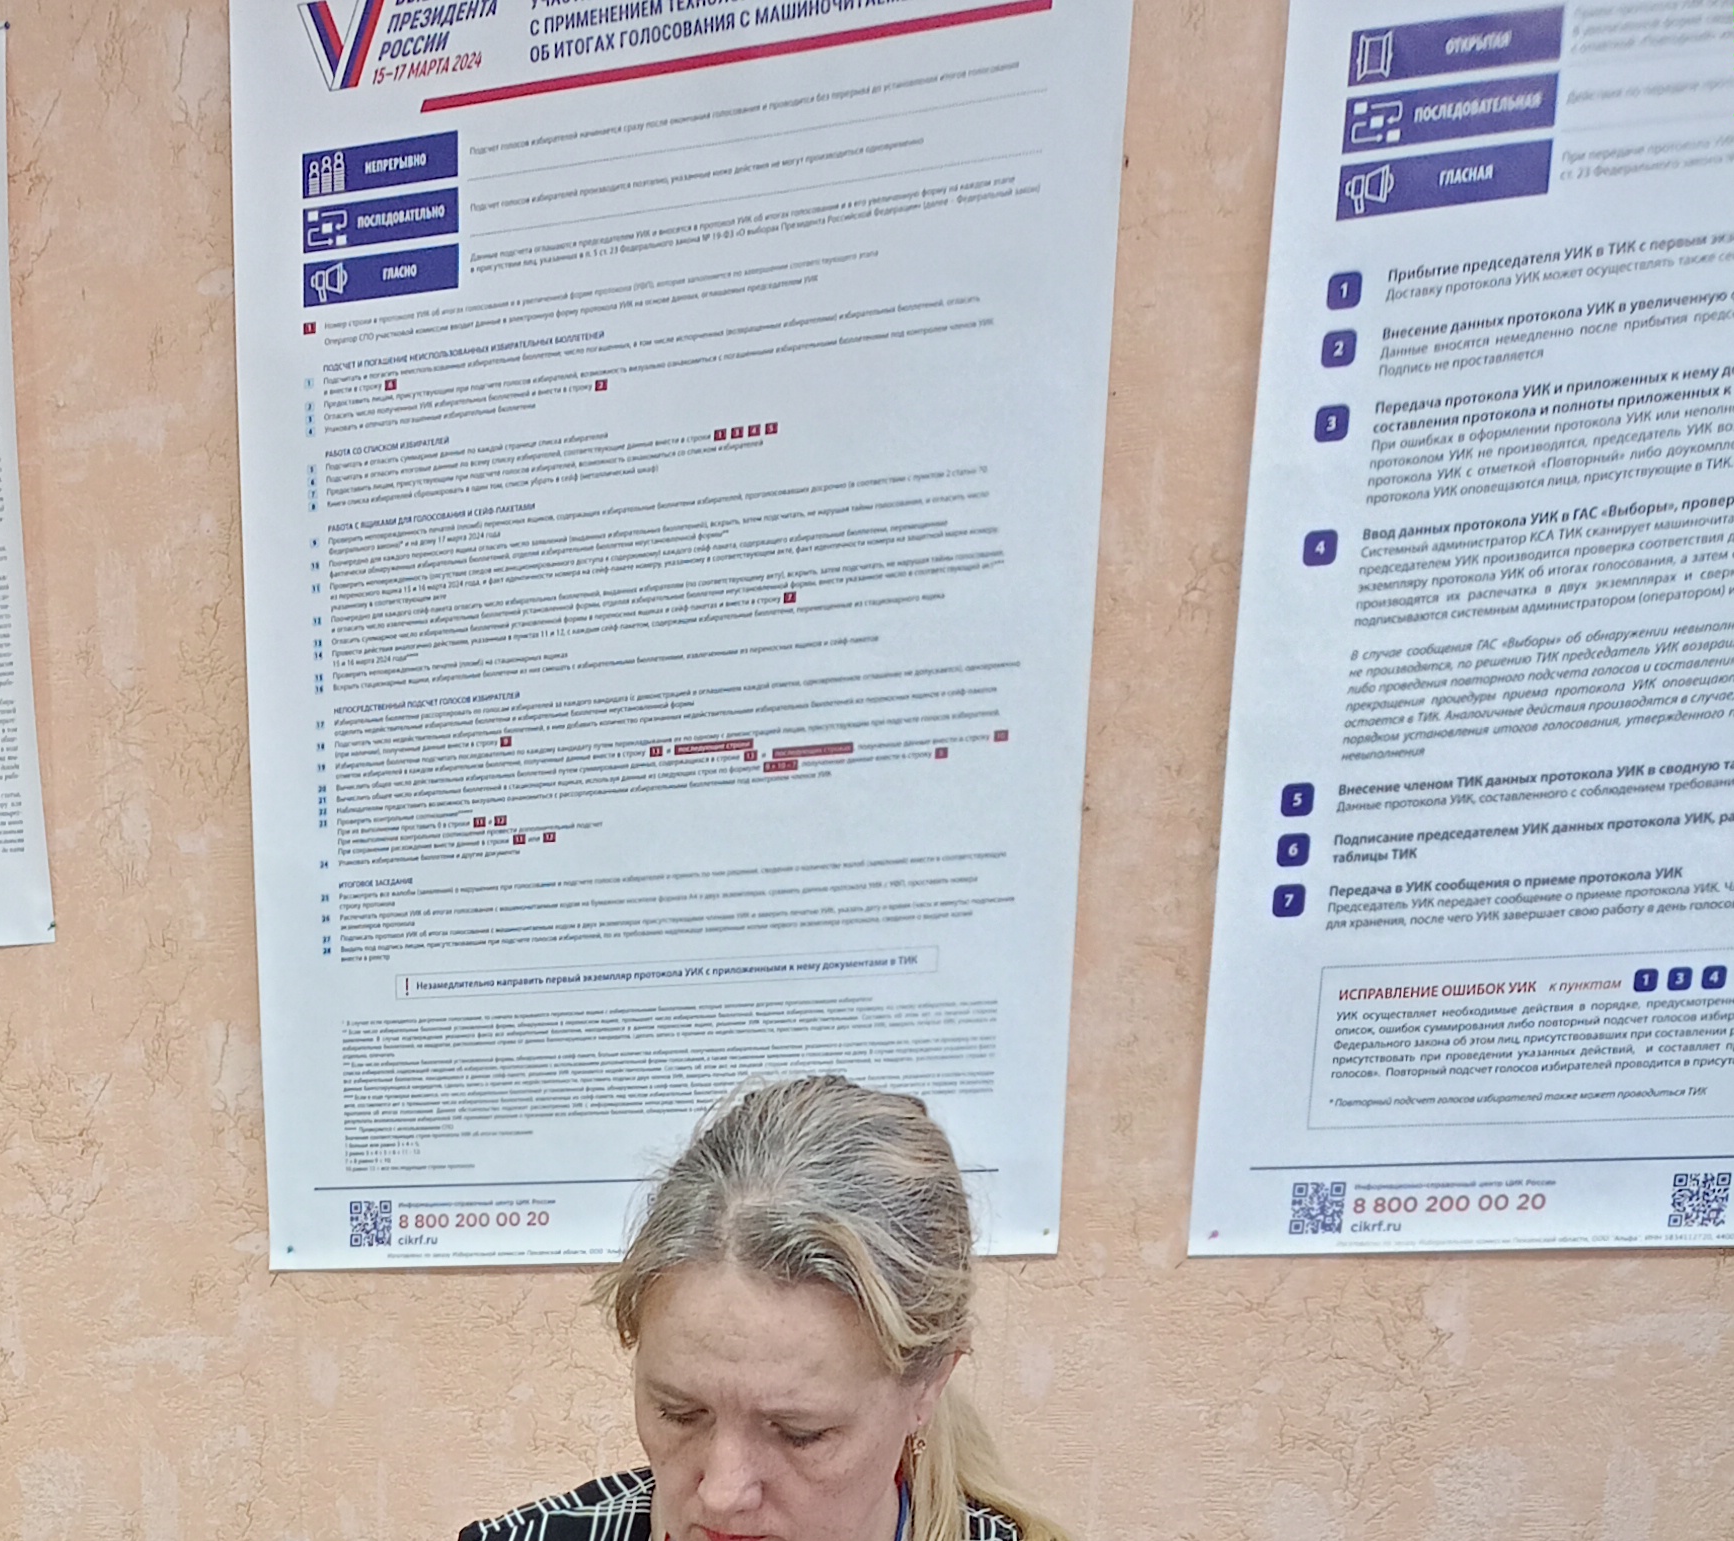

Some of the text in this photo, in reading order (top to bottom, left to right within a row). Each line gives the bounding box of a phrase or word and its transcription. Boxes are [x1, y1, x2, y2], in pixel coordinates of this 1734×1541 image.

[387, 0, 498, 34] ПРЕЗИДЕНТА
[529, 18, 539, 36] С
[544, 0, 664, 34] ПРИМЕНЕНИЕМ
[377, 31, 450, 61] РОССИИ
[529, 43, 550, 63] ОБ
[553, 32, 615, 59] ИТОГАХ
[619, 11, 735, 48] ГОЛОСОВАНИЯ
[739, 9, 750, 28] С
[1444, 29, 1512, 55] ОТКРЫТАЯ
[372, 51, 482, 85] 15–17 МАРТА 2024
[1413, 91, 1542, 122] ПОСЛЕДОВАТЕЛЬНАЯ
[364, 152, 426, 174] НЕПРЕРЫВНО
[1438, 163, 1493, 186] ГЛАСНАЯ
[356, 204, 445, 228] ПОСЛЕДОВАТЕЛЬНО
[382, 263, 417, 280] ГЛАСНО
[1387, 263, 1459, 284] Прибытие
[1461, 251, 1560, 275] председателя
[1563, 244, 1593, 261] УИК
[1595, 246, 1604, 257] в
[1607, 239, 1636, 255] ТИК
[1638, 241, 1645, 252] с
[1340, 281, 1348, 298] 1
[1374, 366, 1719, 416] Передача протокола УИК и приложенных к нему
[1326, 415, 1336, 431] 3
[1337, 760, 1720, 796] Внесение членом ТИК данных протокола УИК в сводную
[1292, 792, 1302, 807] 5
[1333, 811, 1715, 847] Подписание председателем УИК данных протокола УИК,
[1287, 842, 1298, 856] 6
[1331, 846, 1418, 863] таблицы ТИК
[1328, 865, 1683, 899] Передача в УИК сообщения о приеме протокола УИК
[1284, 893, 1294, 907] 7
[1338, 970, 1719, 1001] ИСПРАВЛЕНИЕ ОШИБОК УИК к пунктам 1 3 4
[1352, 1192, 1546, 1214] 8 800 200 00 20
[397, 1210, 550, 1229] 8 800 200 00 20
[1350, 1219, 1402, 1234] cikrf.ru
[397, 1233, 438, 1246] cikrf.ru
